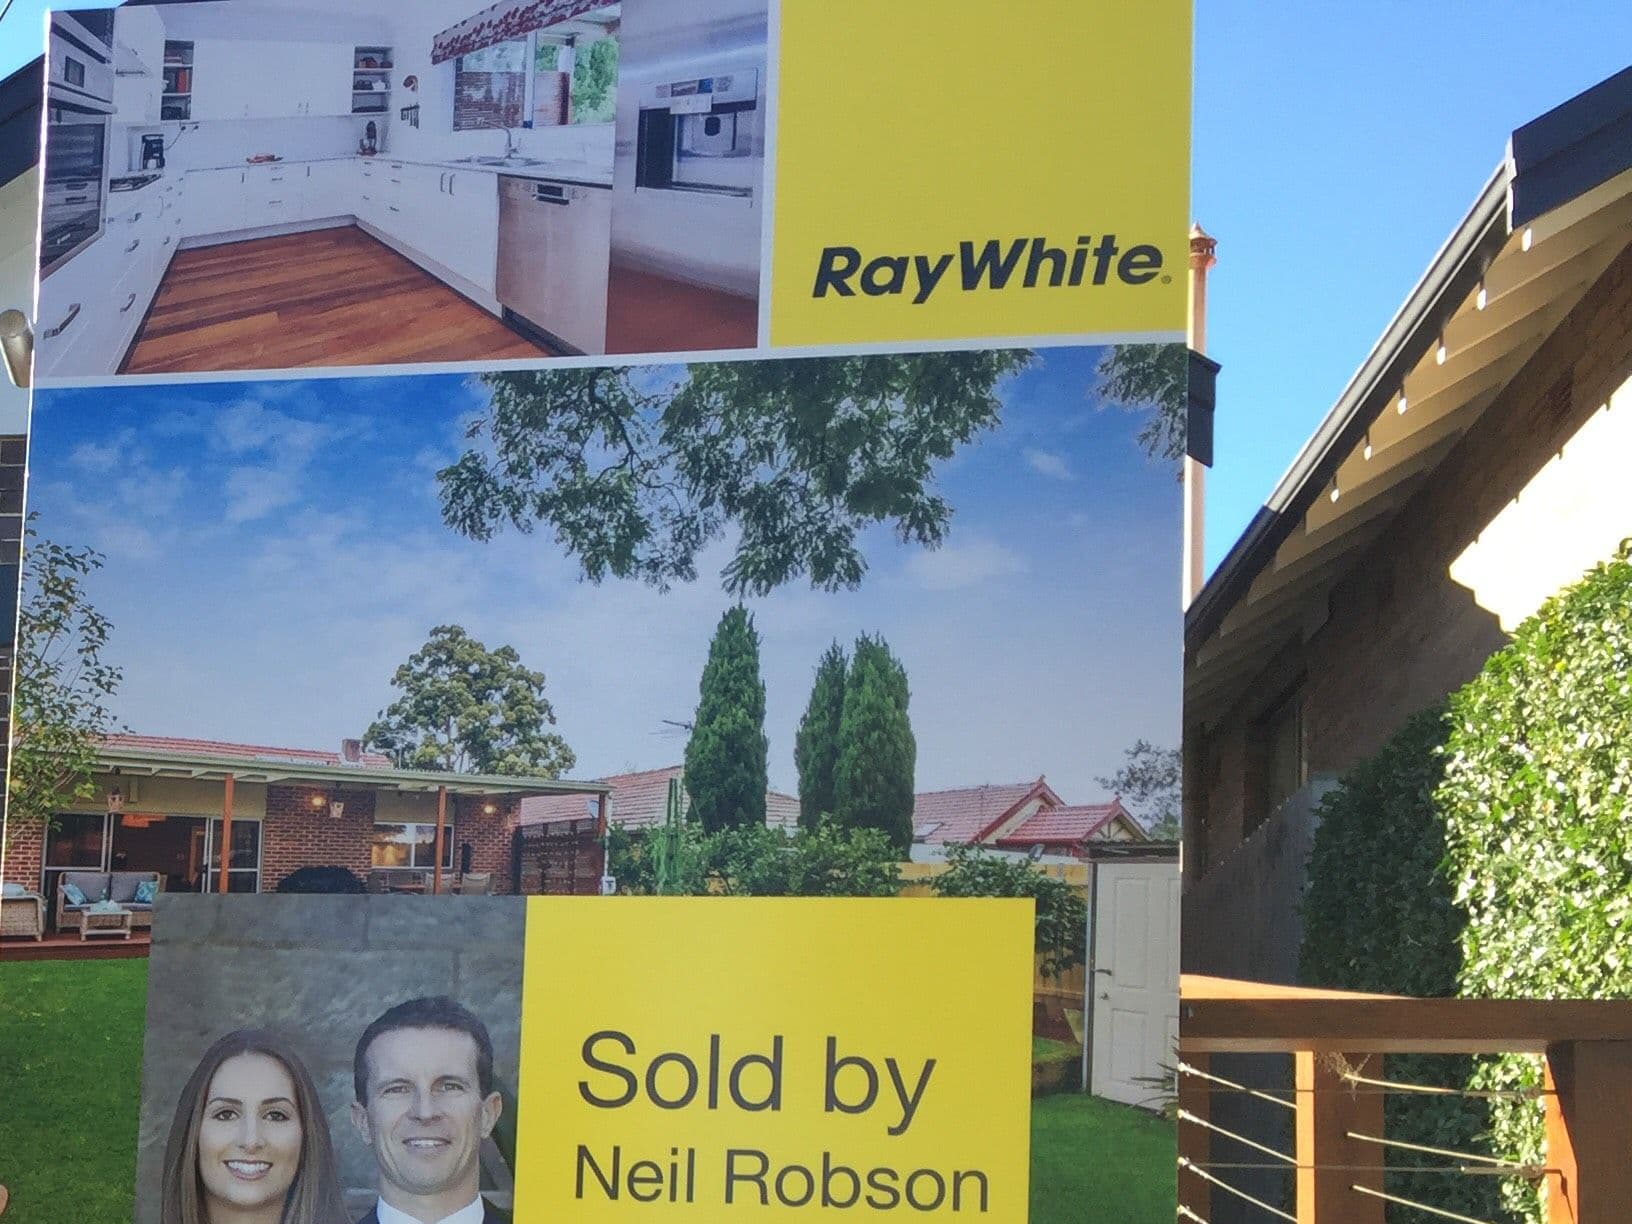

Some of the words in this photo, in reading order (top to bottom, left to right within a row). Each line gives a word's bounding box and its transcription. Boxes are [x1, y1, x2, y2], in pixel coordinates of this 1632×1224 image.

[578, 1031, 783, 1111] Sold
[825, 1036, 936, 1136] by
[576, 1145, 695, 1202] Neil
[725, 1149, 987, 1212] Robson
